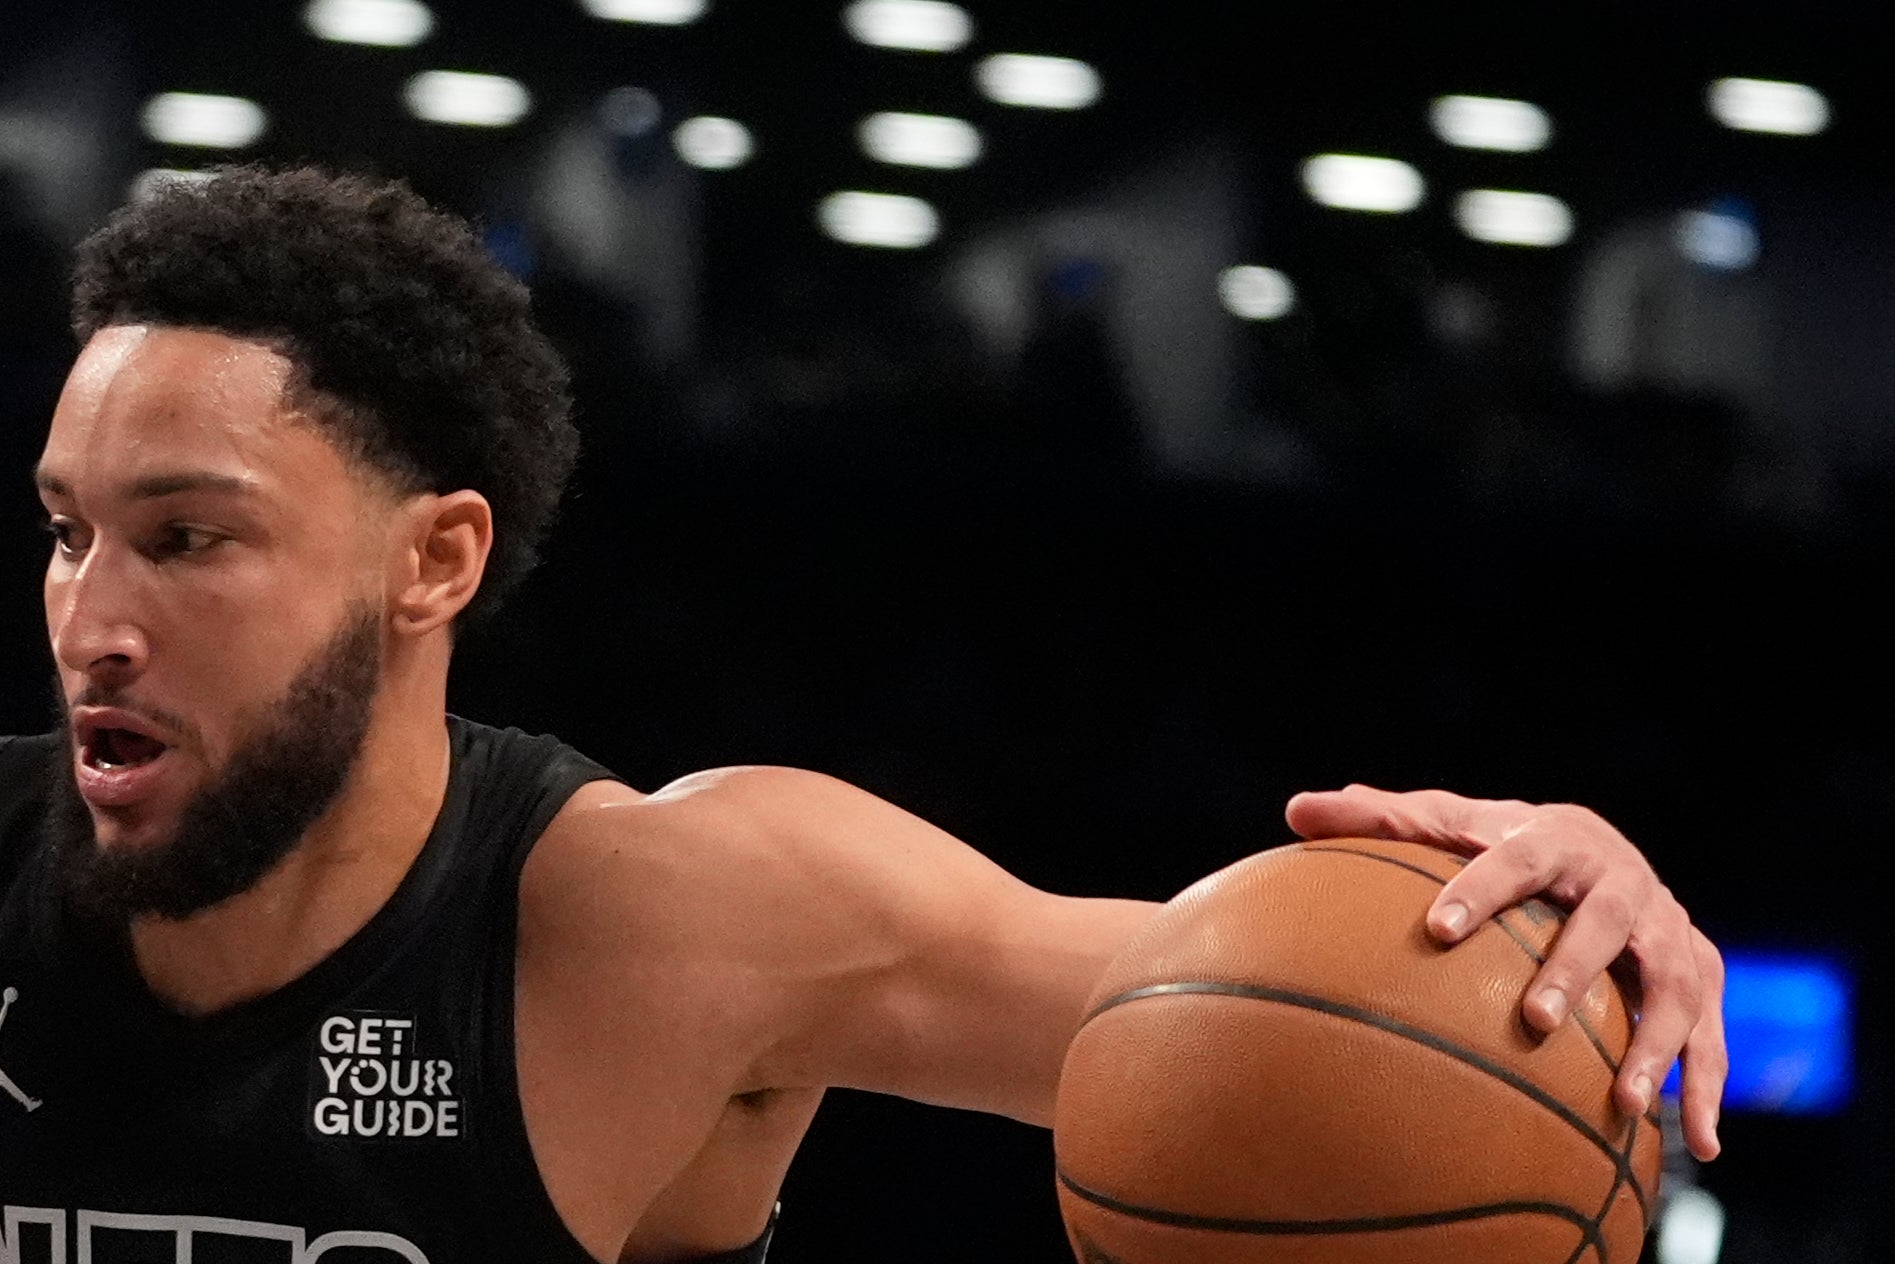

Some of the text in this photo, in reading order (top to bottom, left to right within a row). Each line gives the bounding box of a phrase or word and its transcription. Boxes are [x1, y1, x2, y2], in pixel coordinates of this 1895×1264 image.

[320, 1016, 413, 1056] GET
[318, 1056, 454, 1097] YOUR
[313, 1097, 459, 1137] GUIDE
